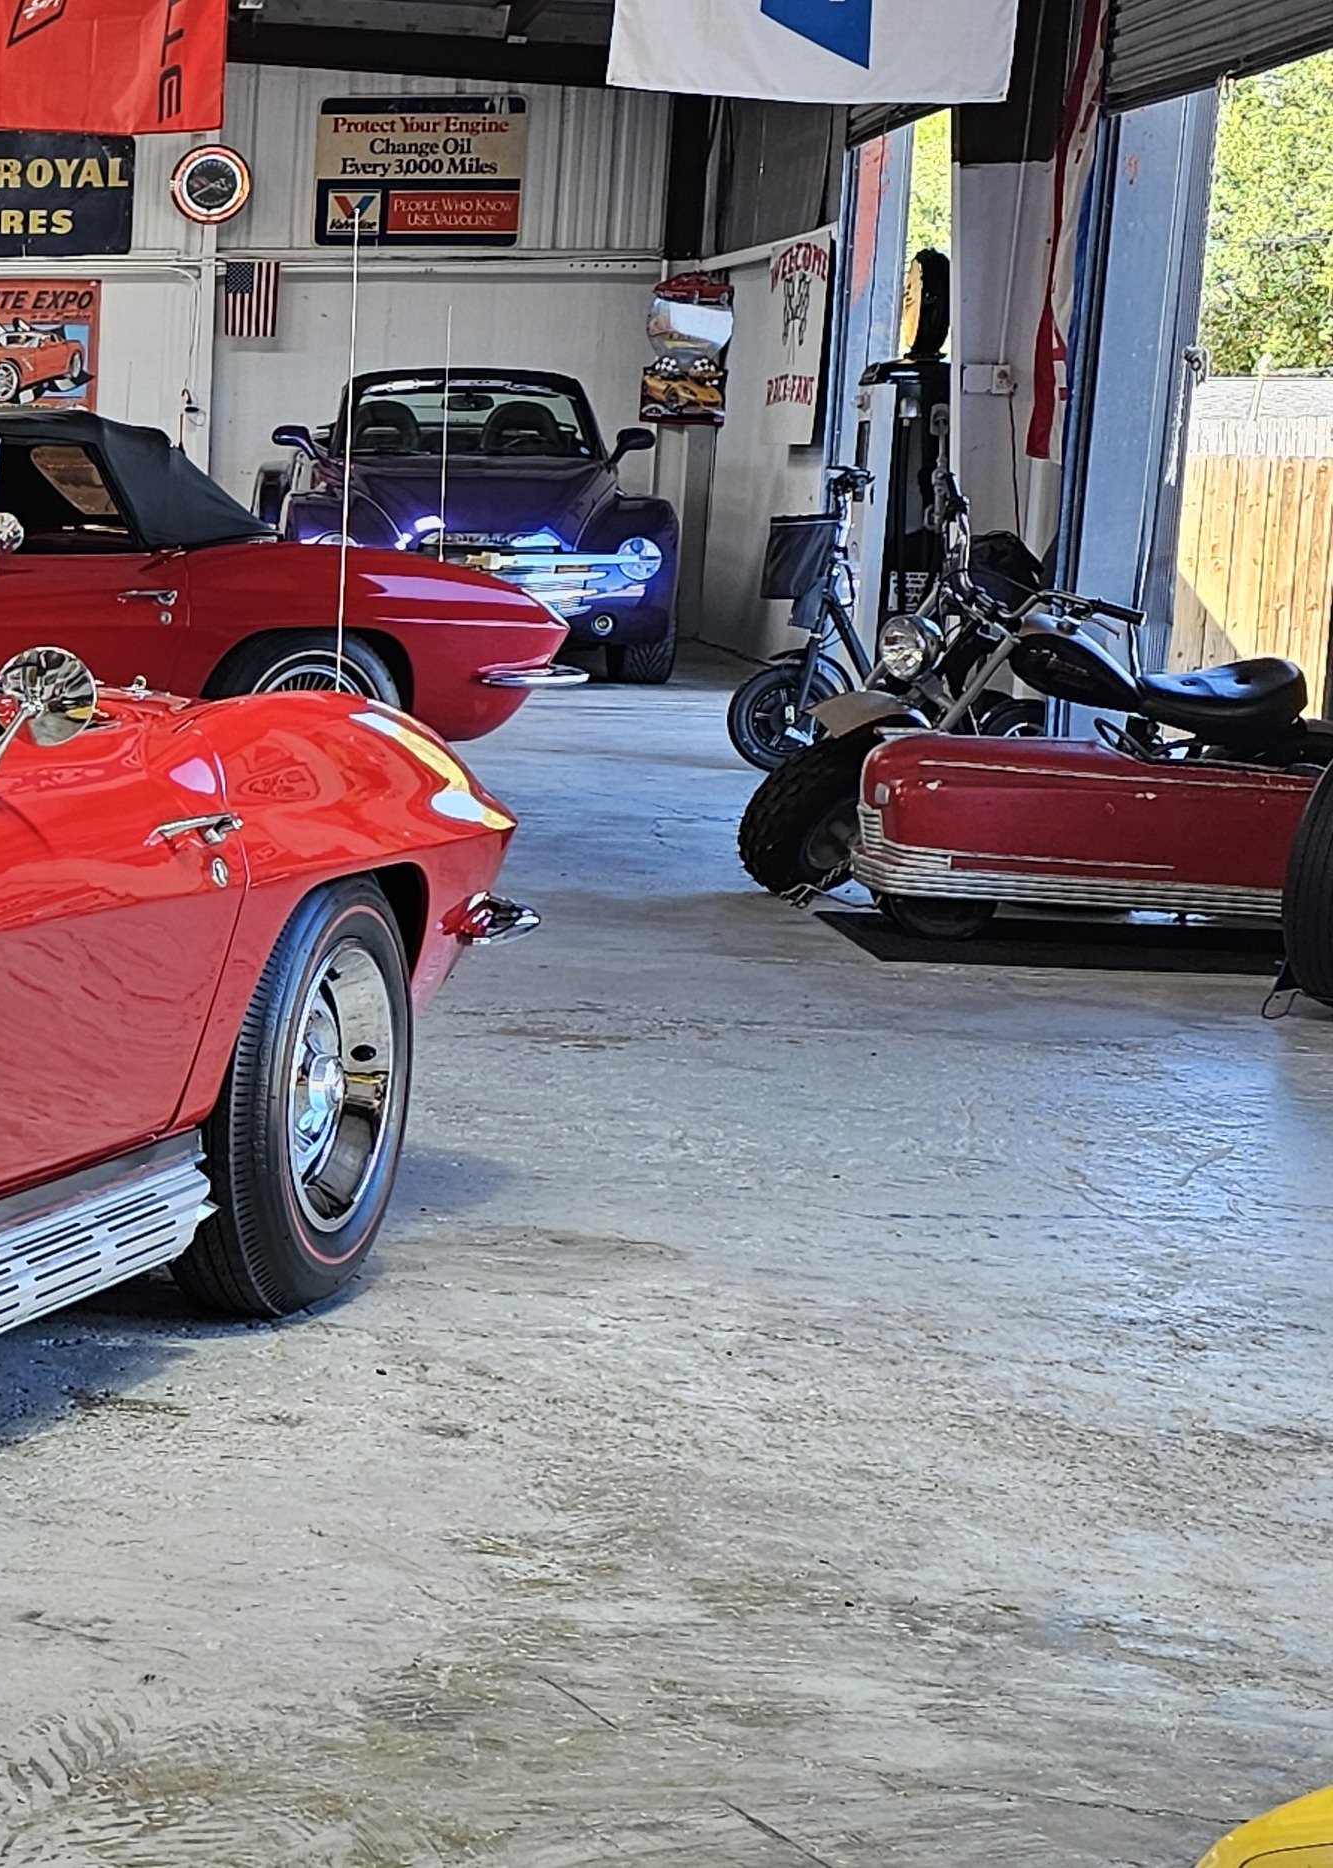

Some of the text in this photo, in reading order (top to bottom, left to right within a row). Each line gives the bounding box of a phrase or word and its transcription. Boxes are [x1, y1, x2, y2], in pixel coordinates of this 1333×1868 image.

[332, 116, 509, 135] Protect Your Engine
[369, 138, 472, 157] Change Oil
[341, 157, 498, 177] Every 3,000 Miles
[393, 199, 513, 212] PEOPLE WHO KNOW
[407, 214, 497, 226] USE VALVOLINE
[771, 243, 828, 293] WELCOME
[31, 290, 94, 310] EXPO
